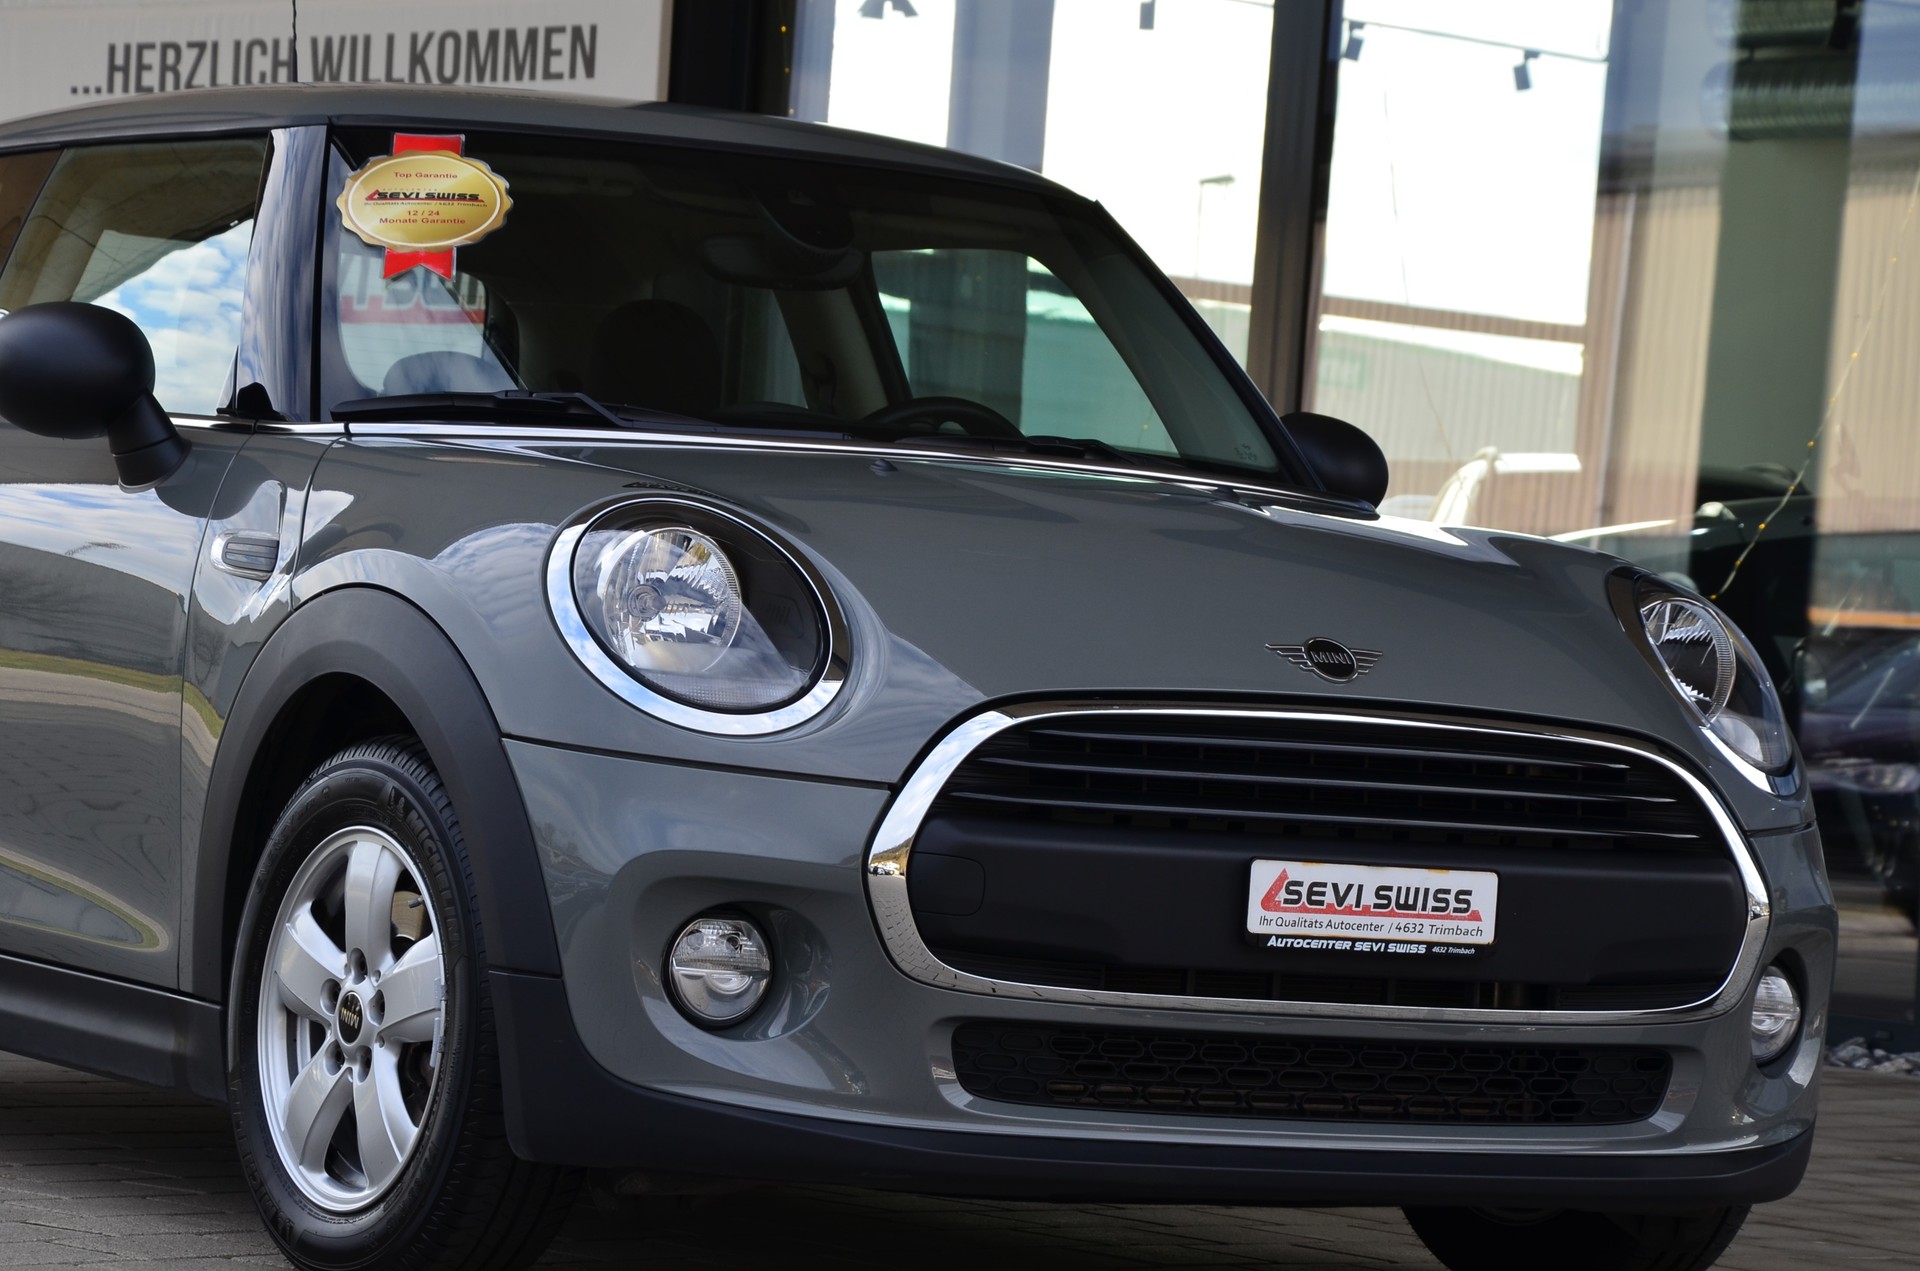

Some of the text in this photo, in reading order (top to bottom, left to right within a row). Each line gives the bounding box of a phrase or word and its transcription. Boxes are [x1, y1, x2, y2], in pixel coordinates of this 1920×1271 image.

[309, 23, 598, 84] WILLKOMMEN
[377, 191, 480, 201] SEVI SWISS
[1310, 651, 1351, 665] MINI
[1282, 880, 1473, 914] SEVI SWISS
[1259, 915, 1274, 926] Ihr
[1325, 919, 1385, 932] Autocenter
[1395, 921, 1424, 934] 4632
[1428, 924, 1483, 937] Trimbach
[1354, 941, 1386, 952] SEVI
[1387, 943, 1427, 954] SWISS
[1431, 946, 1447, 954] 4632
[1447, 946, 1475, 955] Trimbach
[341, 1007, 360, 1029] MINI
